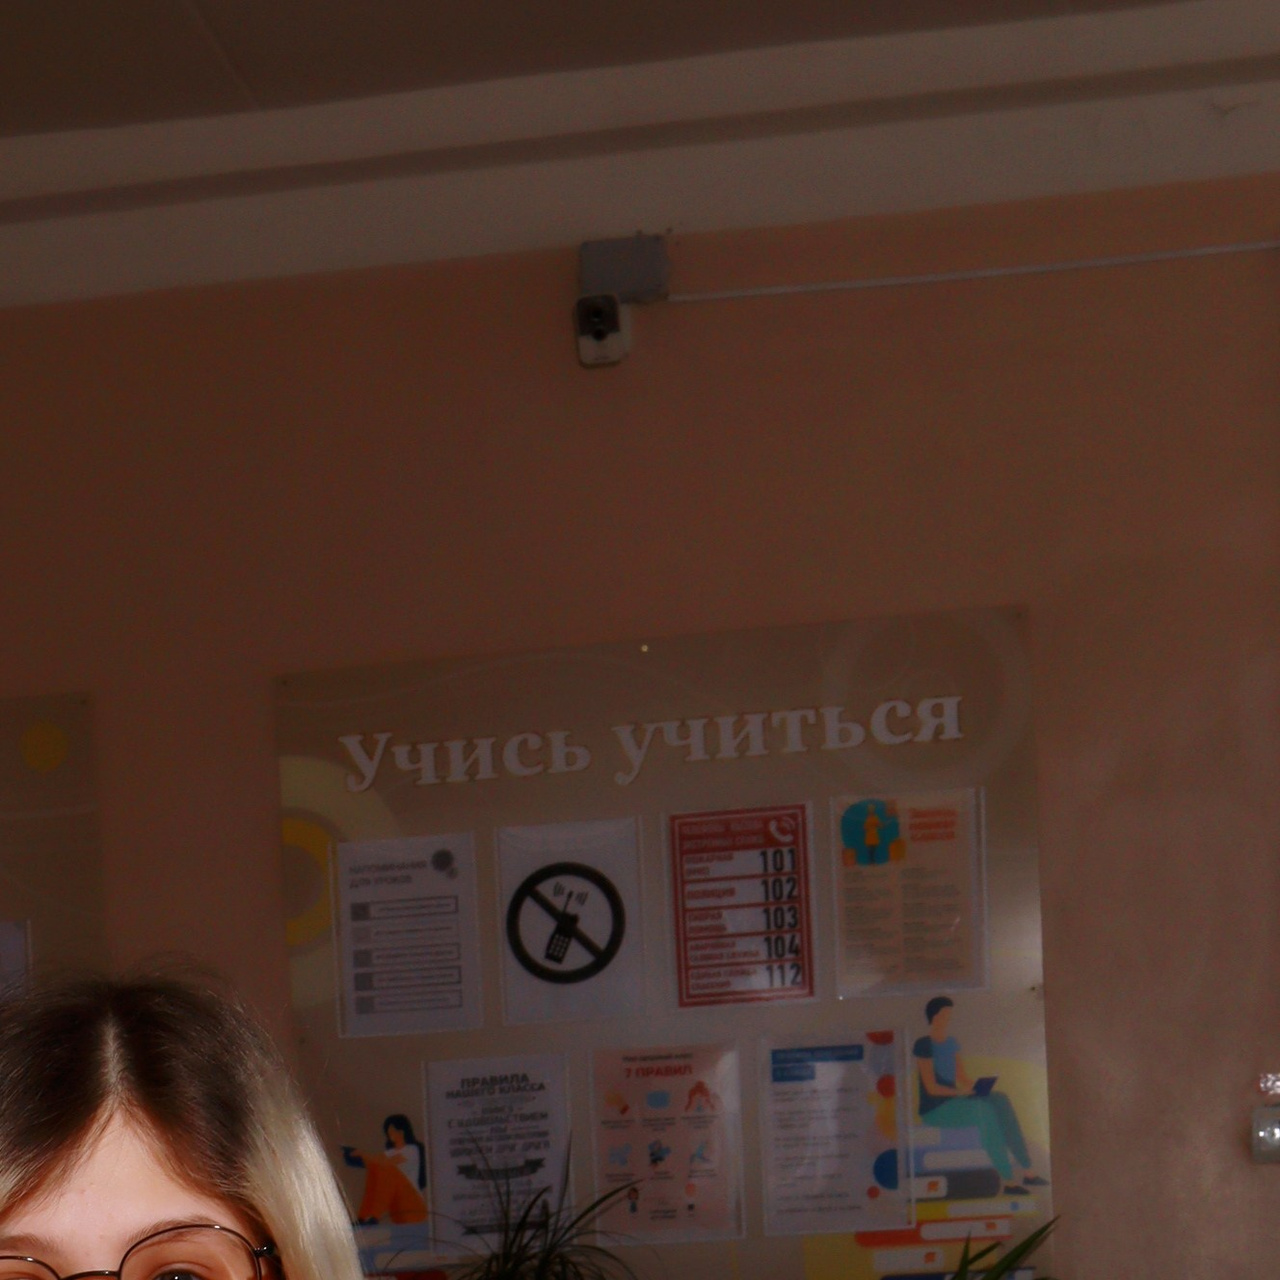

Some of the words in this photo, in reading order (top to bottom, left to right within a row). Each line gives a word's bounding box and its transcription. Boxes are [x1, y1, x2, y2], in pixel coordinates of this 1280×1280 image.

[340, 730, 591, 792] Учись
[611, 694, 965, 786] учиться
[759, 848, 796, 873] 101
[761, 876, 798, 902] 102
[763, 905, 799, 931] 103
[764, 933, 800, 959] 104
[766, 963, 802, 988] 112
[460, 1073, 529, 1089] ПРАВИЛА
[625, 1067, 632, 1078] 7
[635, 1064, 693, 1078] ПРАВИЛ
[445, 1086, 495, 1099] НАШЕГО
[498, 1082, 545, 1095] КЛАССА
